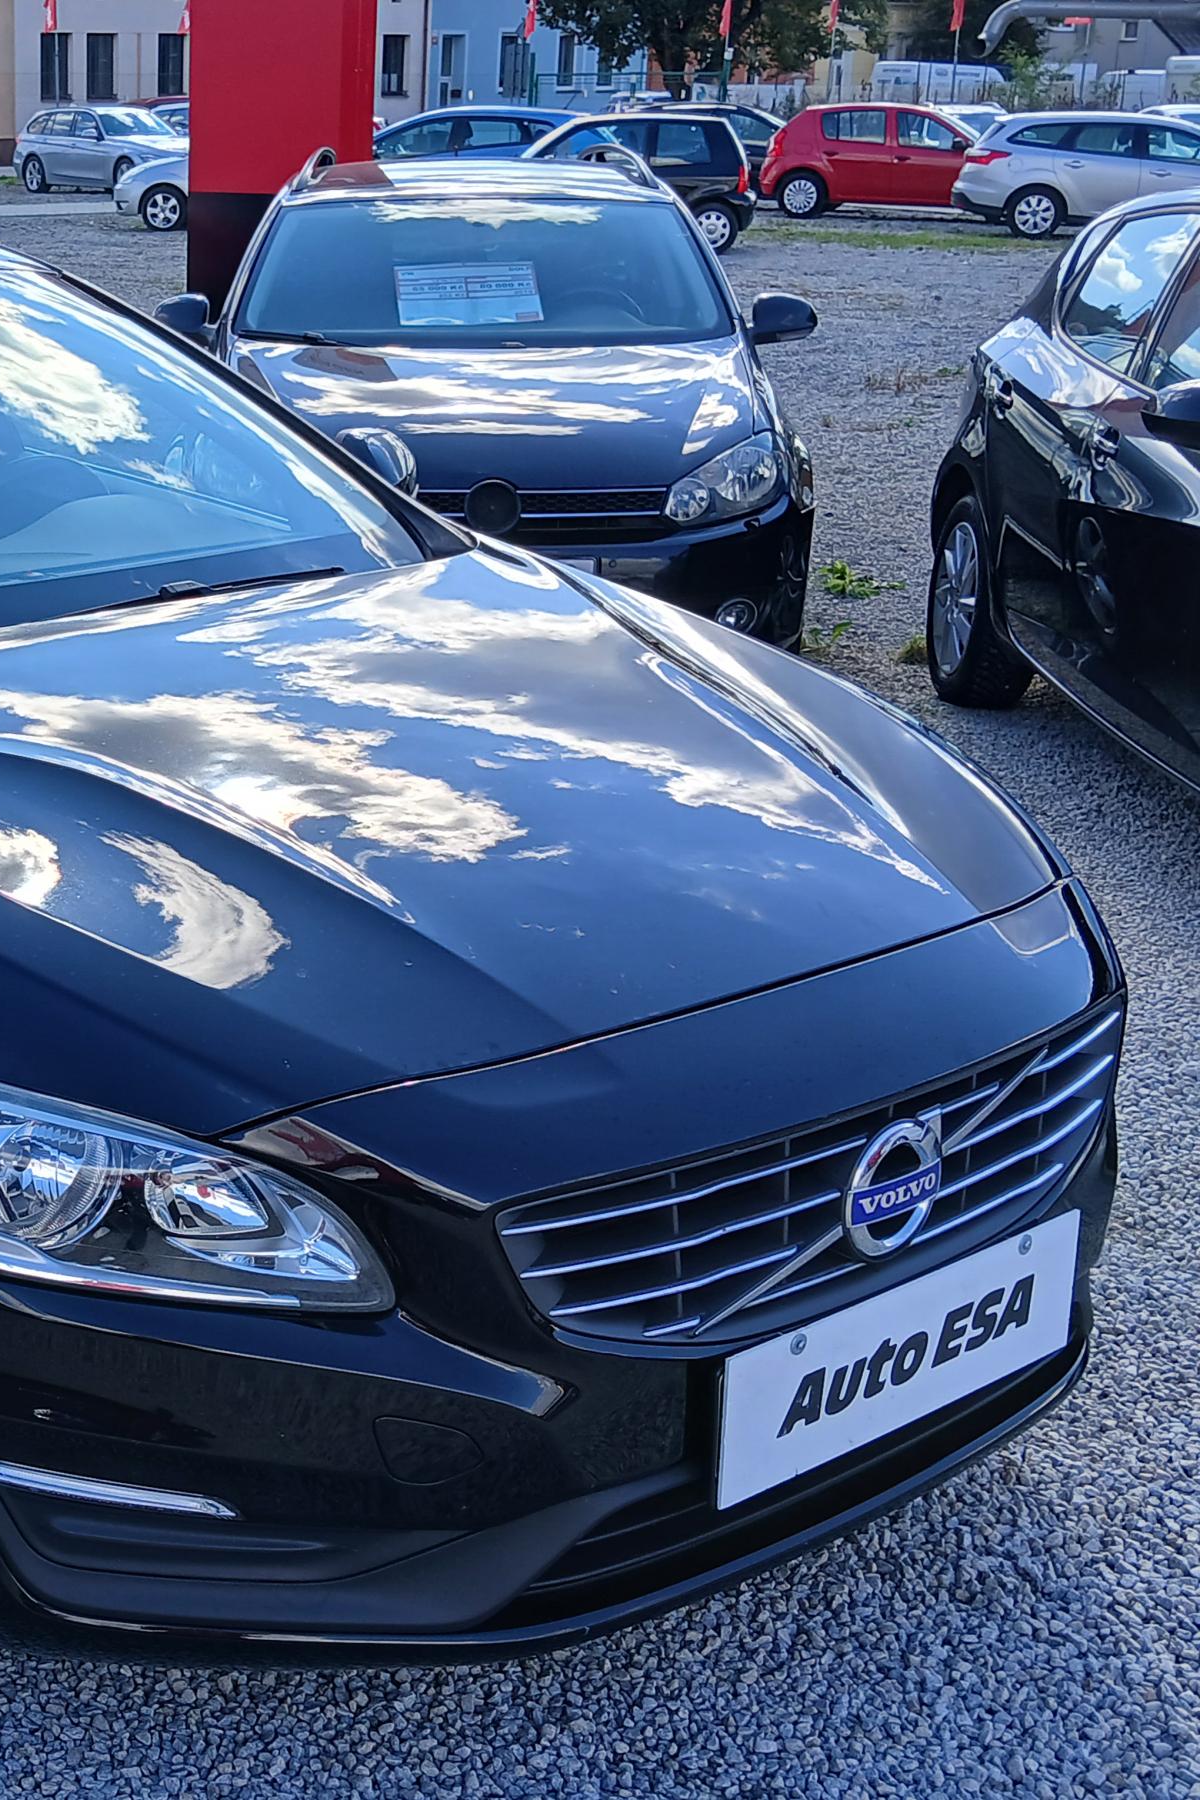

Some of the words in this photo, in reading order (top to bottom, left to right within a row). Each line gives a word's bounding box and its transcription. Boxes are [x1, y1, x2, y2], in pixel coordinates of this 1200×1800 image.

[858, 1172, 936, 1215] VOLVO
[776, 1332, 929, 1439] Auto
[931, 1274, 1035, 1369] ESA
